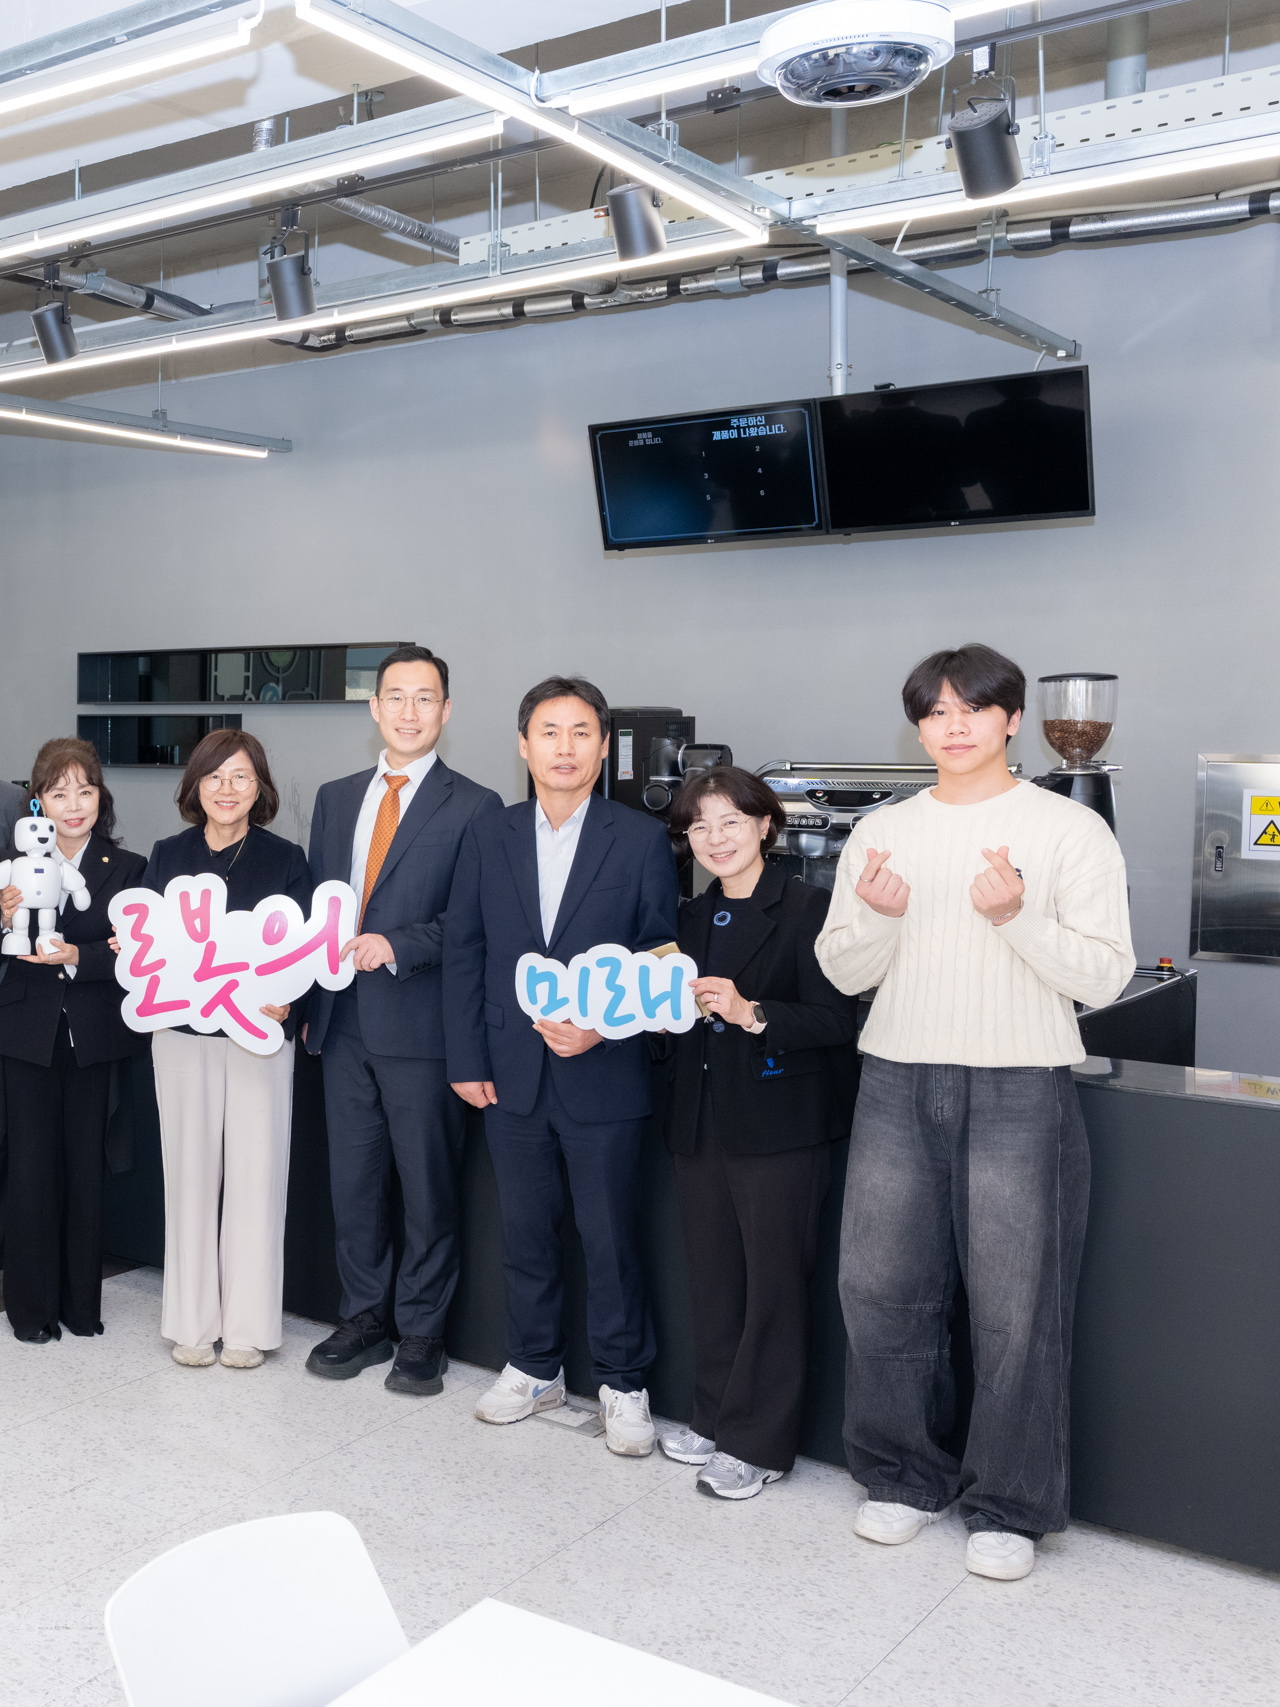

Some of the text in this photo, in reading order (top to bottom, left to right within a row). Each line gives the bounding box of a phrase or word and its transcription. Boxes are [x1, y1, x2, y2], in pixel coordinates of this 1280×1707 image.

[712, 424, 787, 441] 제품이 나왔습니다.
[730, 415, 765, 428] 주문하신
[122, 888, 342, 1040] 로봇의
[526, 956, 684, 1027] 미래
